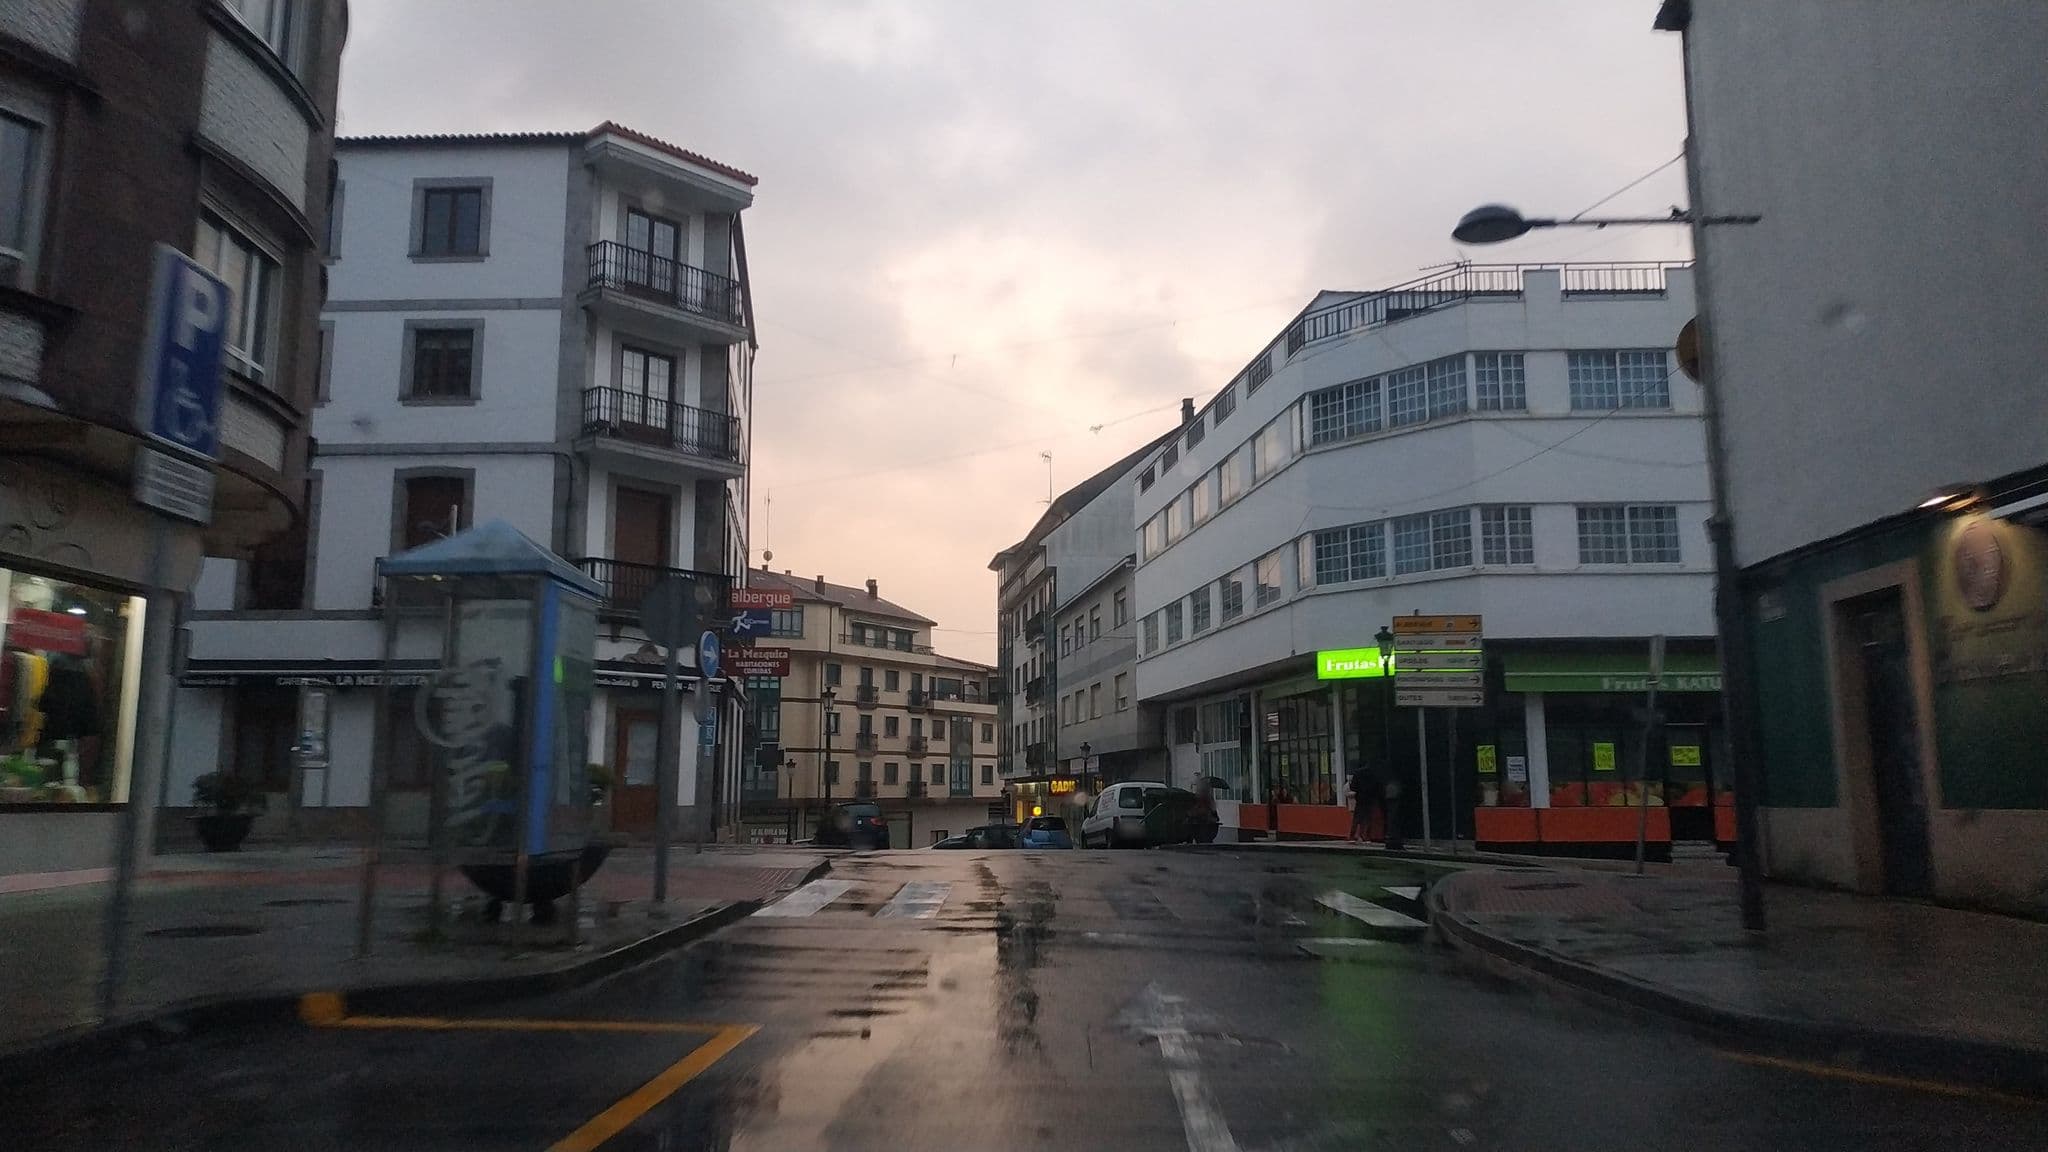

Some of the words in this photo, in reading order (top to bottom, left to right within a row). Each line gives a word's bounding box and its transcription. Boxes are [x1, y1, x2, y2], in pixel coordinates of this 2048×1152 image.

[731, 590, 791, 607] albergue
[728, 648, 740, 659] La
[742, 649, 789, 661] Mezquita
[1326, 657, 1377, 673] Frutas
